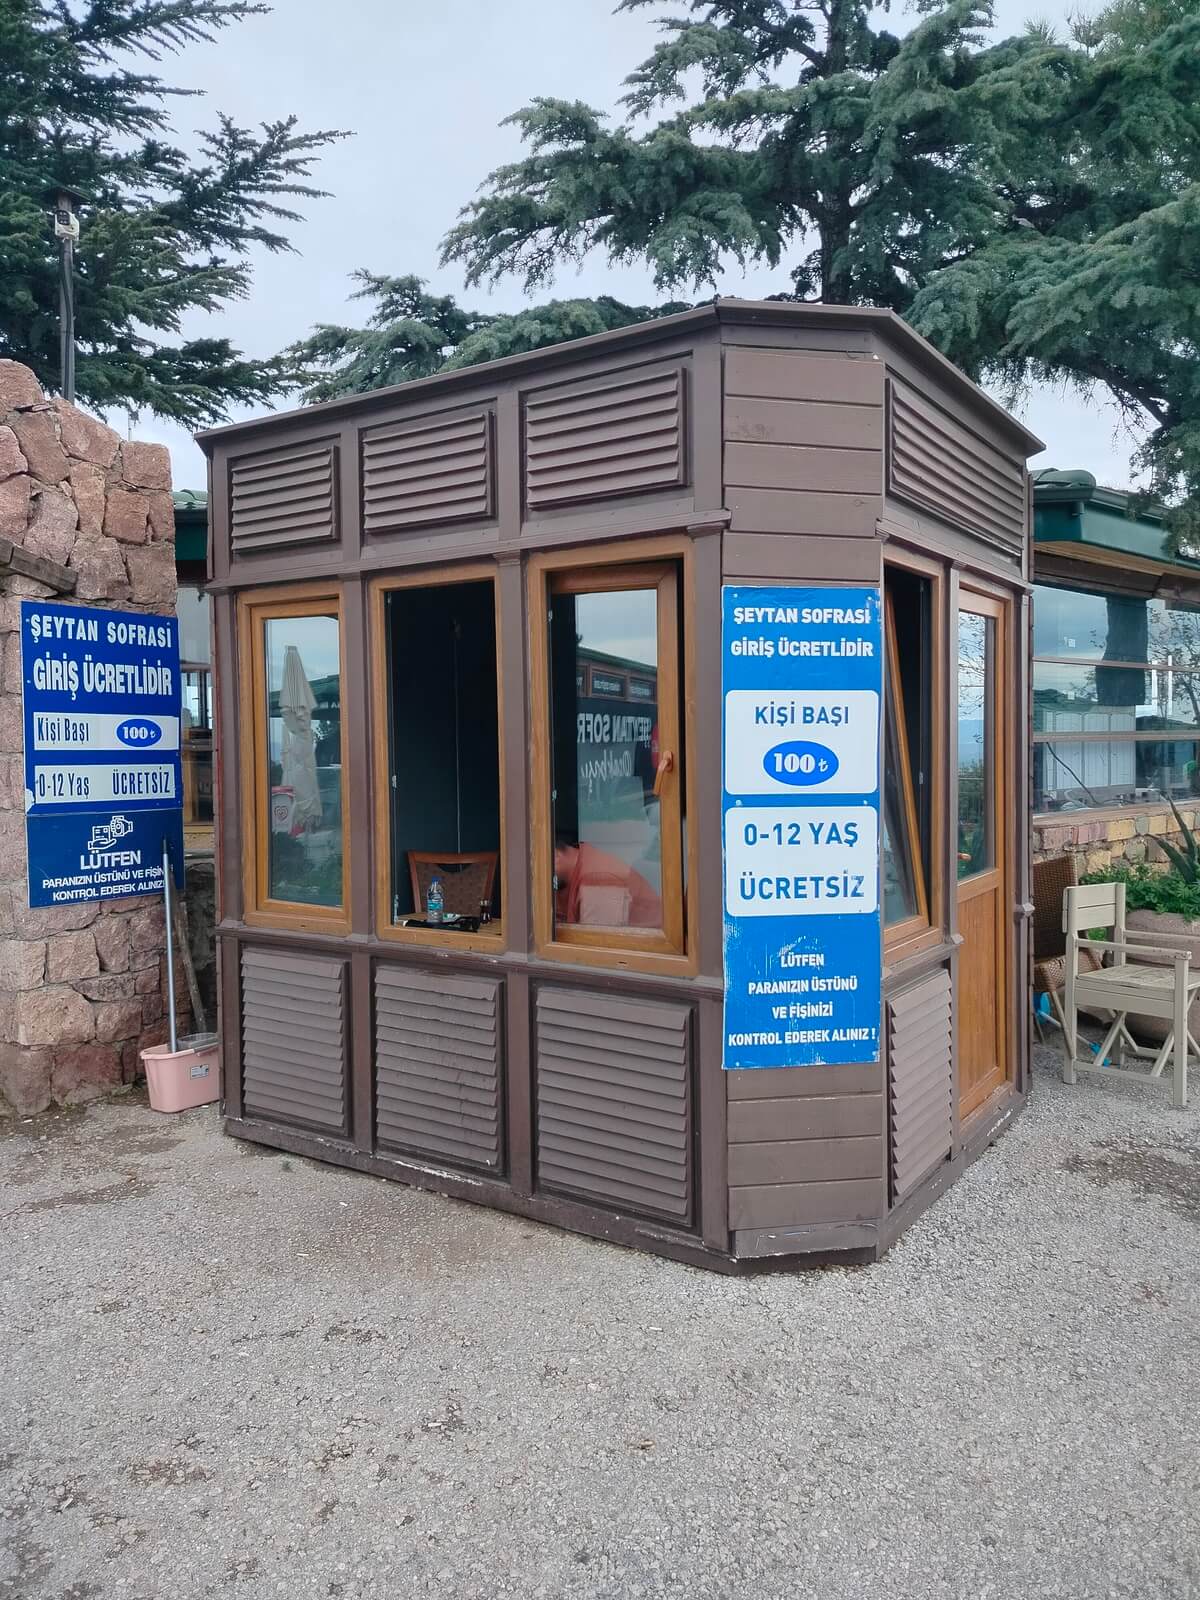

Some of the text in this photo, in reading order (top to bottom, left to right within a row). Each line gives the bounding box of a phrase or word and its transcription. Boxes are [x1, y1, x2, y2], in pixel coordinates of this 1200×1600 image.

[733, 607, 798, 624] ŞEYTAN
[30, 614, 98, 643] ŞEYTAN
[730, 636, 874, 658] GİRİŞ ÜCRETLİDİR
[33, 651, 172, 700] GİRİŞ ÜCRETLİDİR
[755, 701, 849, 727] KİŞİ BAŞI
[37, 717, 89, 744] Kişi Başı
[39, 766, 171, 799] 0-12 Yaş ÜCRETSİZ
[744, 822, 858, 847] 0-12 YAŞ
[80, 849, 141, 870] LÜTFEN
[42, 875, 92, 889] PARANIZIN
[94, 869, 130, 884] ÜSTÜNÜ
[132, 870, 144, 879] VE
[740, 870, 865, 900] ÜCRETSİZ
[53, 888, 99, 901] KONTROL
[100, 883, 135, 896] EDEREK
[781, 952, 824, 968] LÜTFEN
[748, 976, 857, 995] PARANIZIN ÜSTÜNÜ
[772, 1001, 833, 1019] VE FİŞİNİZİ
[728, 1032, 782, 1047] KONTROL
[784, 1030, 830, 1044] EDEREK
